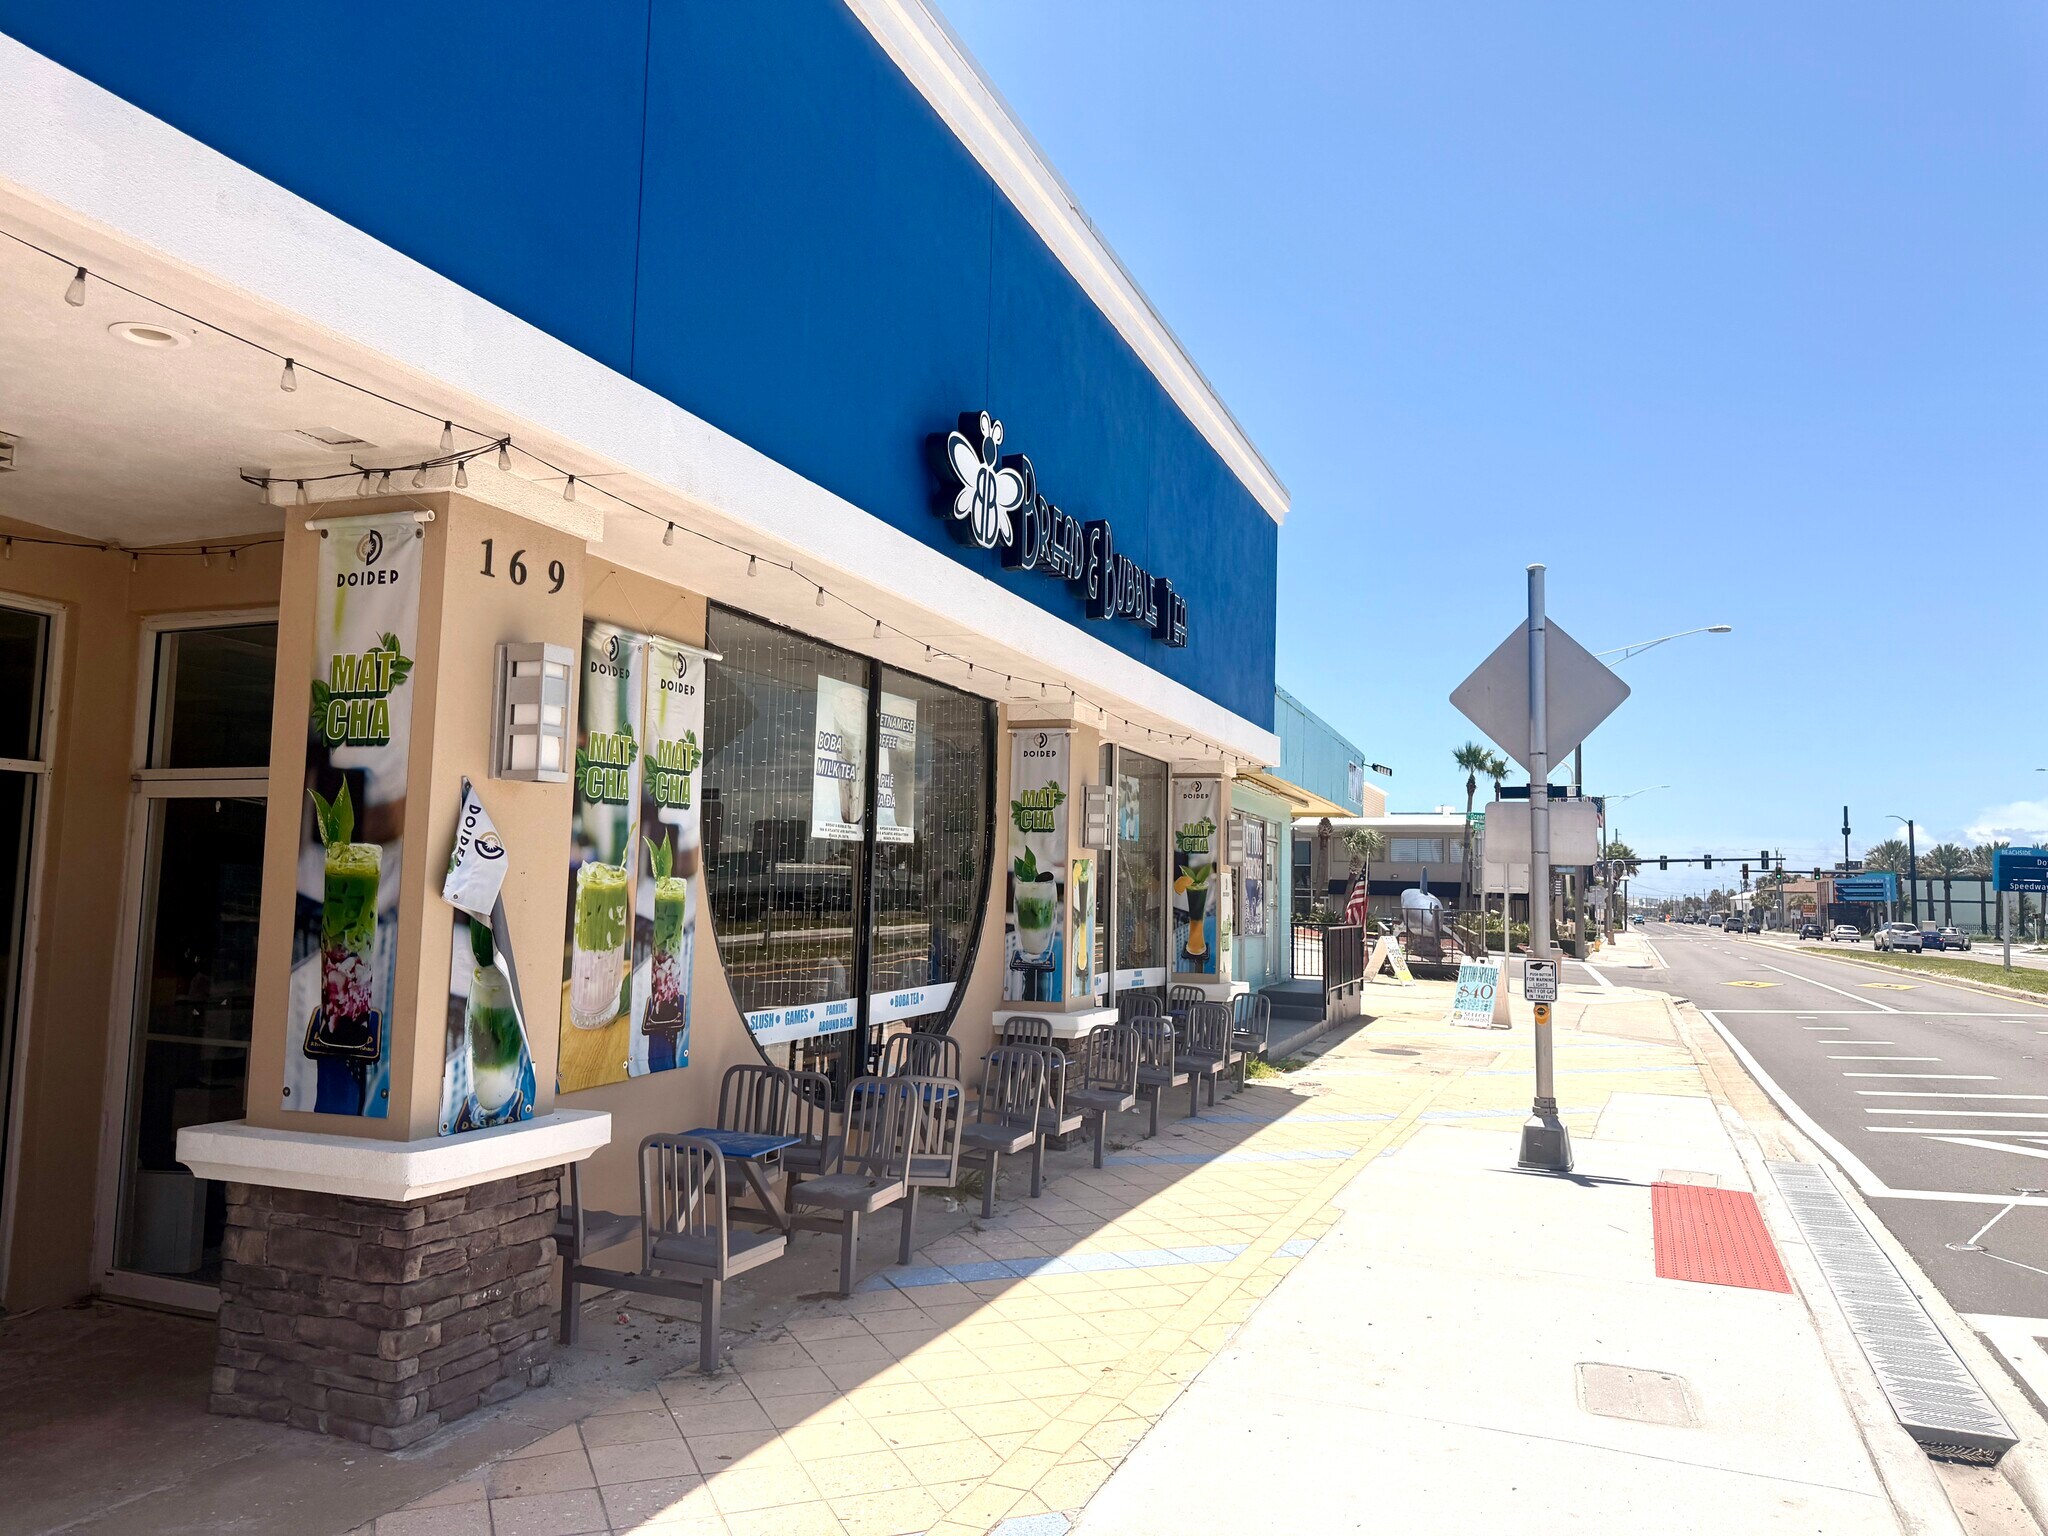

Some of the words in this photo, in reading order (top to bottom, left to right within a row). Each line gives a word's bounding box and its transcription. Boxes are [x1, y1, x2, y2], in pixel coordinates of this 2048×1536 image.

[1022, 453, 1084, 580] BREAD
[1103, 519, 1158, 629] BUBBLE
[1165, 577, 1188, 648] TEA
[480, 538, 565, 595] 169
[336, 569, 399, 588] DOIDEP
[330, 651, 396, 696] MAT
[590, 660, 630, 680] DOIDEP
[660, 679, 695, 696] DOIDEP
[325, 699, 391, 743] CHA
[880, 714, 914, 733] ETNAMESE
[588, 731, 633, 767] MAT
[818, 731, 842, 753] BOBA
[657, 739, 695, 772] MAT
[1023, 750, 1057, 758] DOIDEP
[816, 758, 839, 778] MILK
[841, 762, 856, 781] TEA
[586, 767, 630, 804] CHA
[655, 772, 692, 808] CHA
[1021, 788, 1058, 809] MAT
[1020, 810, 1056, 831] CHA
[1183, 823, 1210, 838] MAT
[1182, 838, 1209, 853] CHA
[894, 994, 909, 1008] BOBA
[909, 992, 919, 1005] TEA
[1457, 984, 1494, 1000] $40
[825, 1002, 848, 1016] PARKING
[750, 1012, 774, 1031] SLUSH
[784, 1009, 809, 1026] GAMES
[818, 1018, 840, 1033] AROUND
[839, 1016, 854, 1029] BACK
